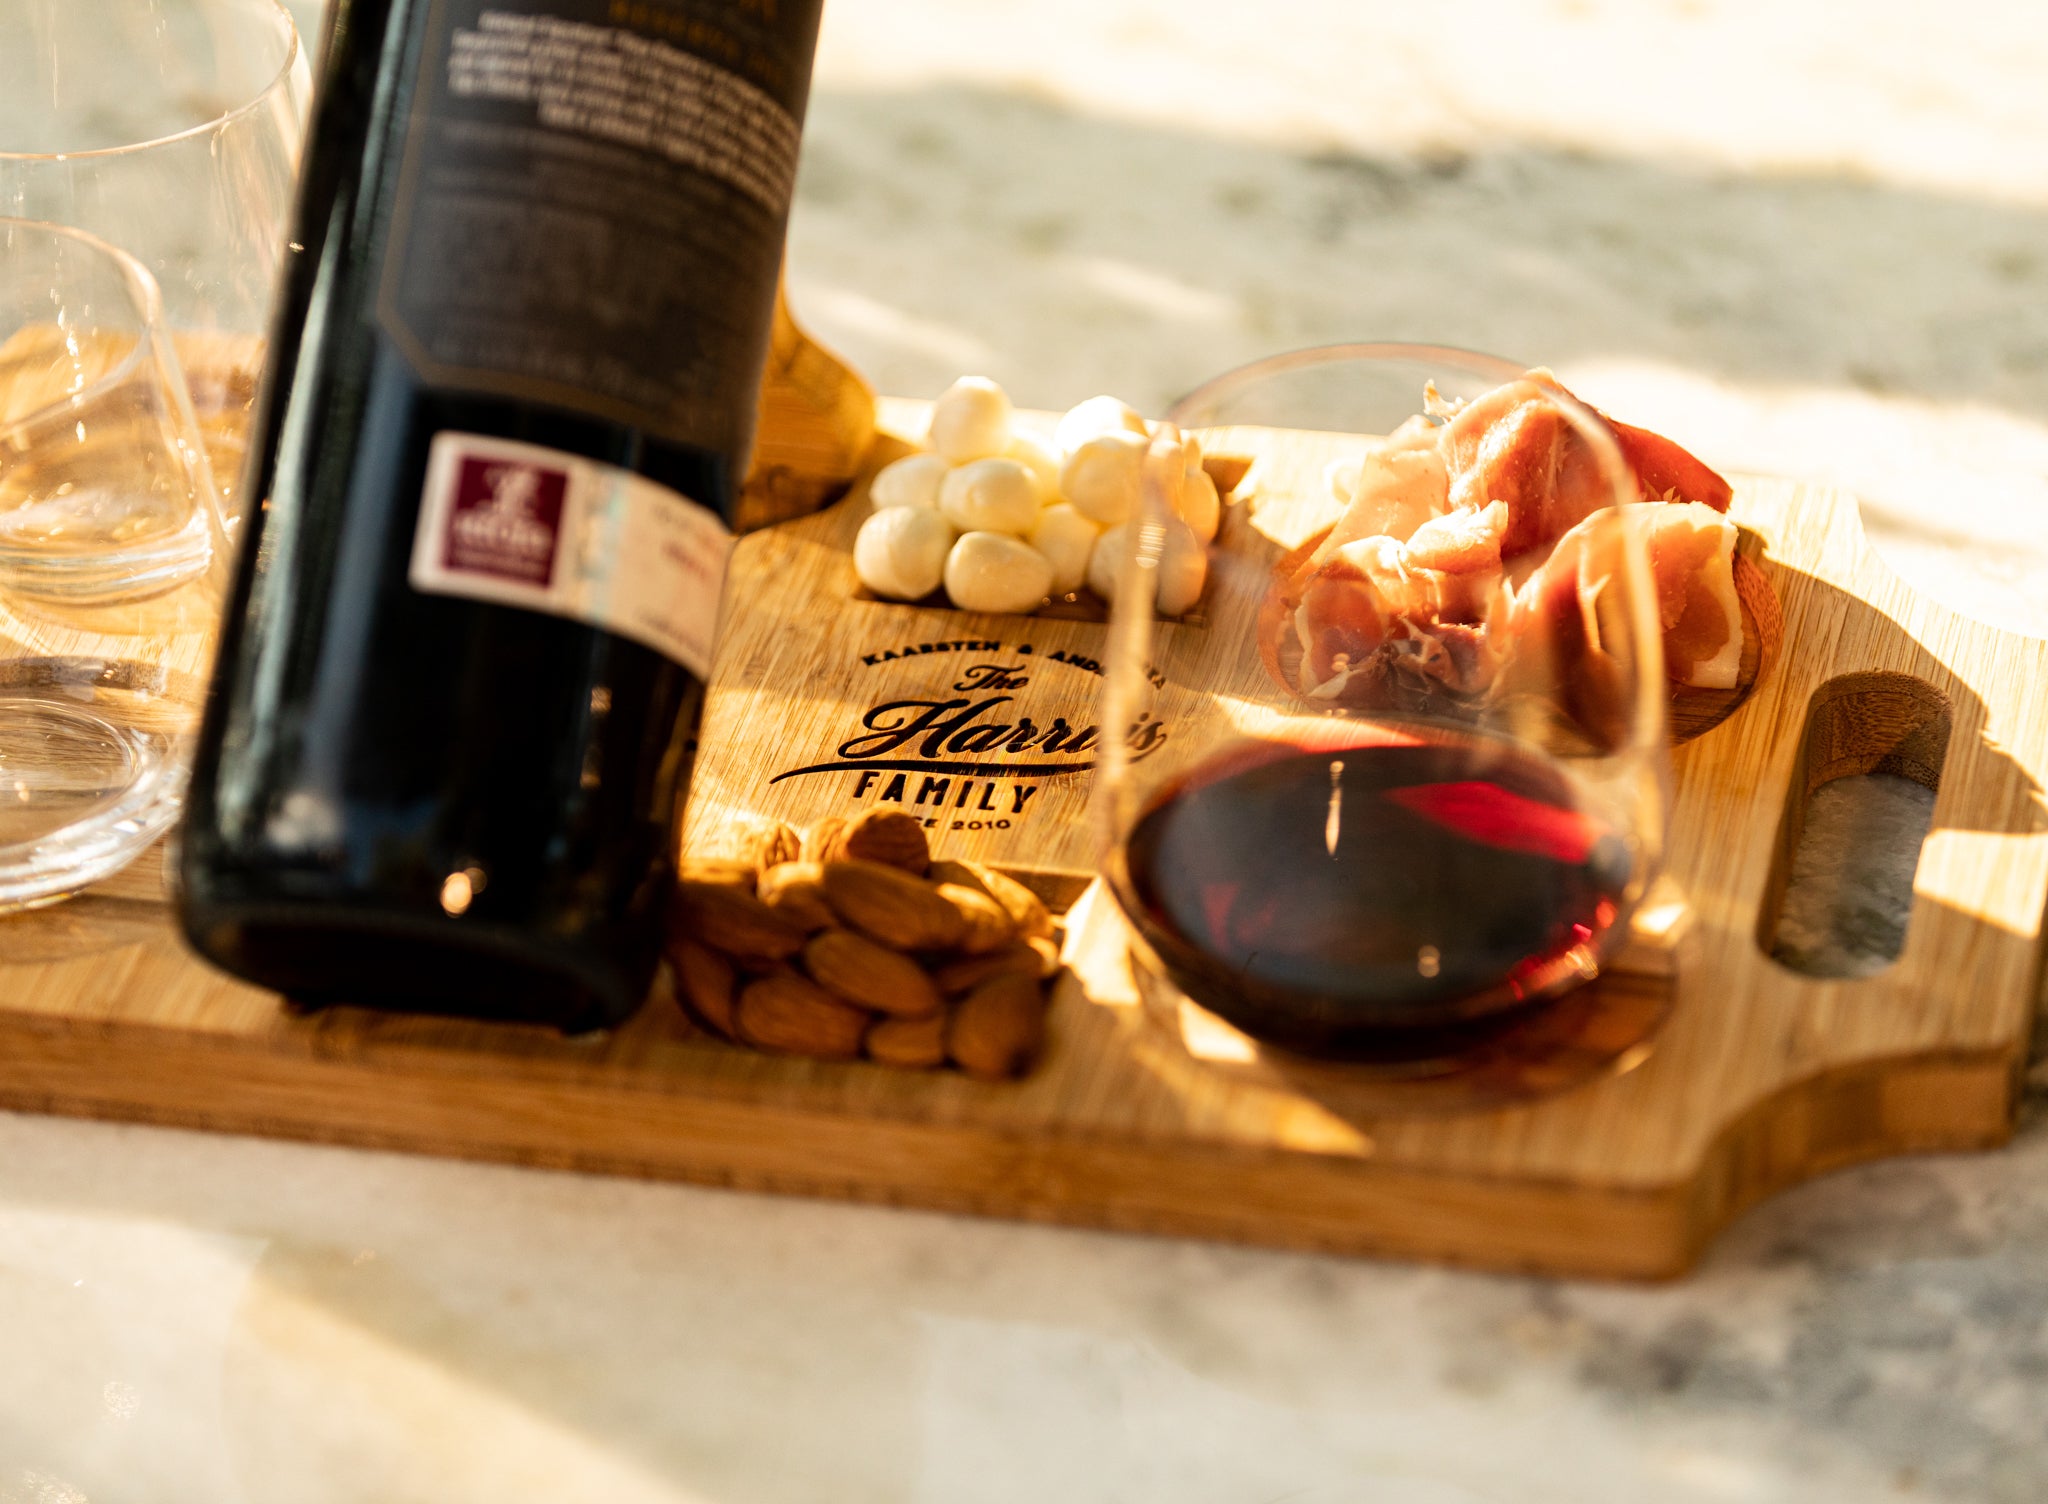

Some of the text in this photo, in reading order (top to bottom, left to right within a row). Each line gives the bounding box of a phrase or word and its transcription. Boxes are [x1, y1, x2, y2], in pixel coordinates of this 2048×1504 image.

[953, 664, 1029, 692] The
[853, 771, 1037, 814] FAMILY
[951, 819, 1011, 831] 2010
